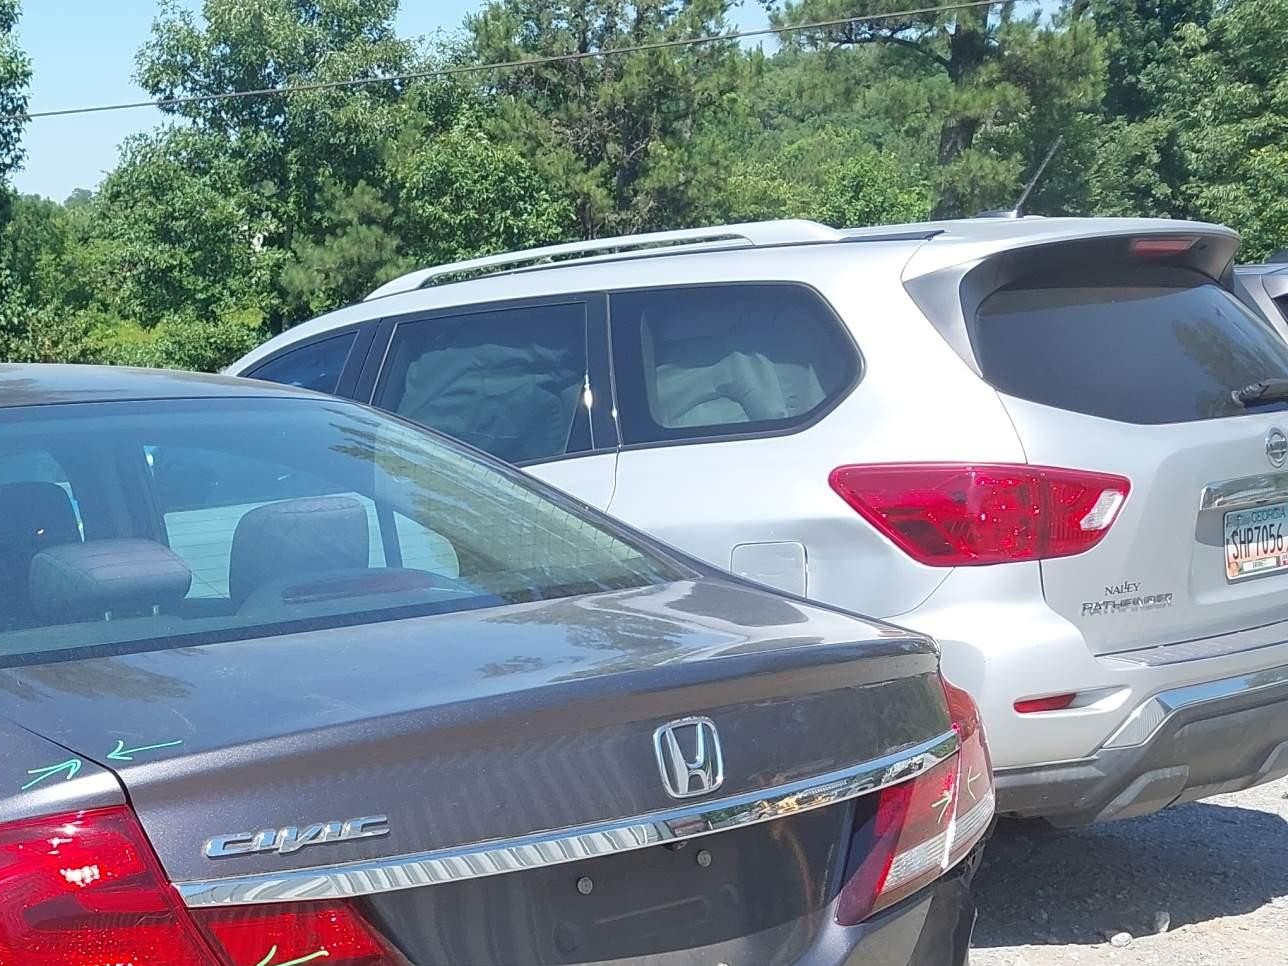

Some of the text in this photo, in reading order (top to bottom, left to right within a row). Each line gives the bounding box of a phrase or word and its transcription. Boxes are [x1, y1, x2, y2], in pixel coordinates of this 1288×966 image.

[1231, 522, 1284, 560] SHP7056
[1081, 592, 1173, 612] PATHFINDER
[1104, 580, 1141, 596] NALLEY
[206, 814, 391, 858] CIVIC
